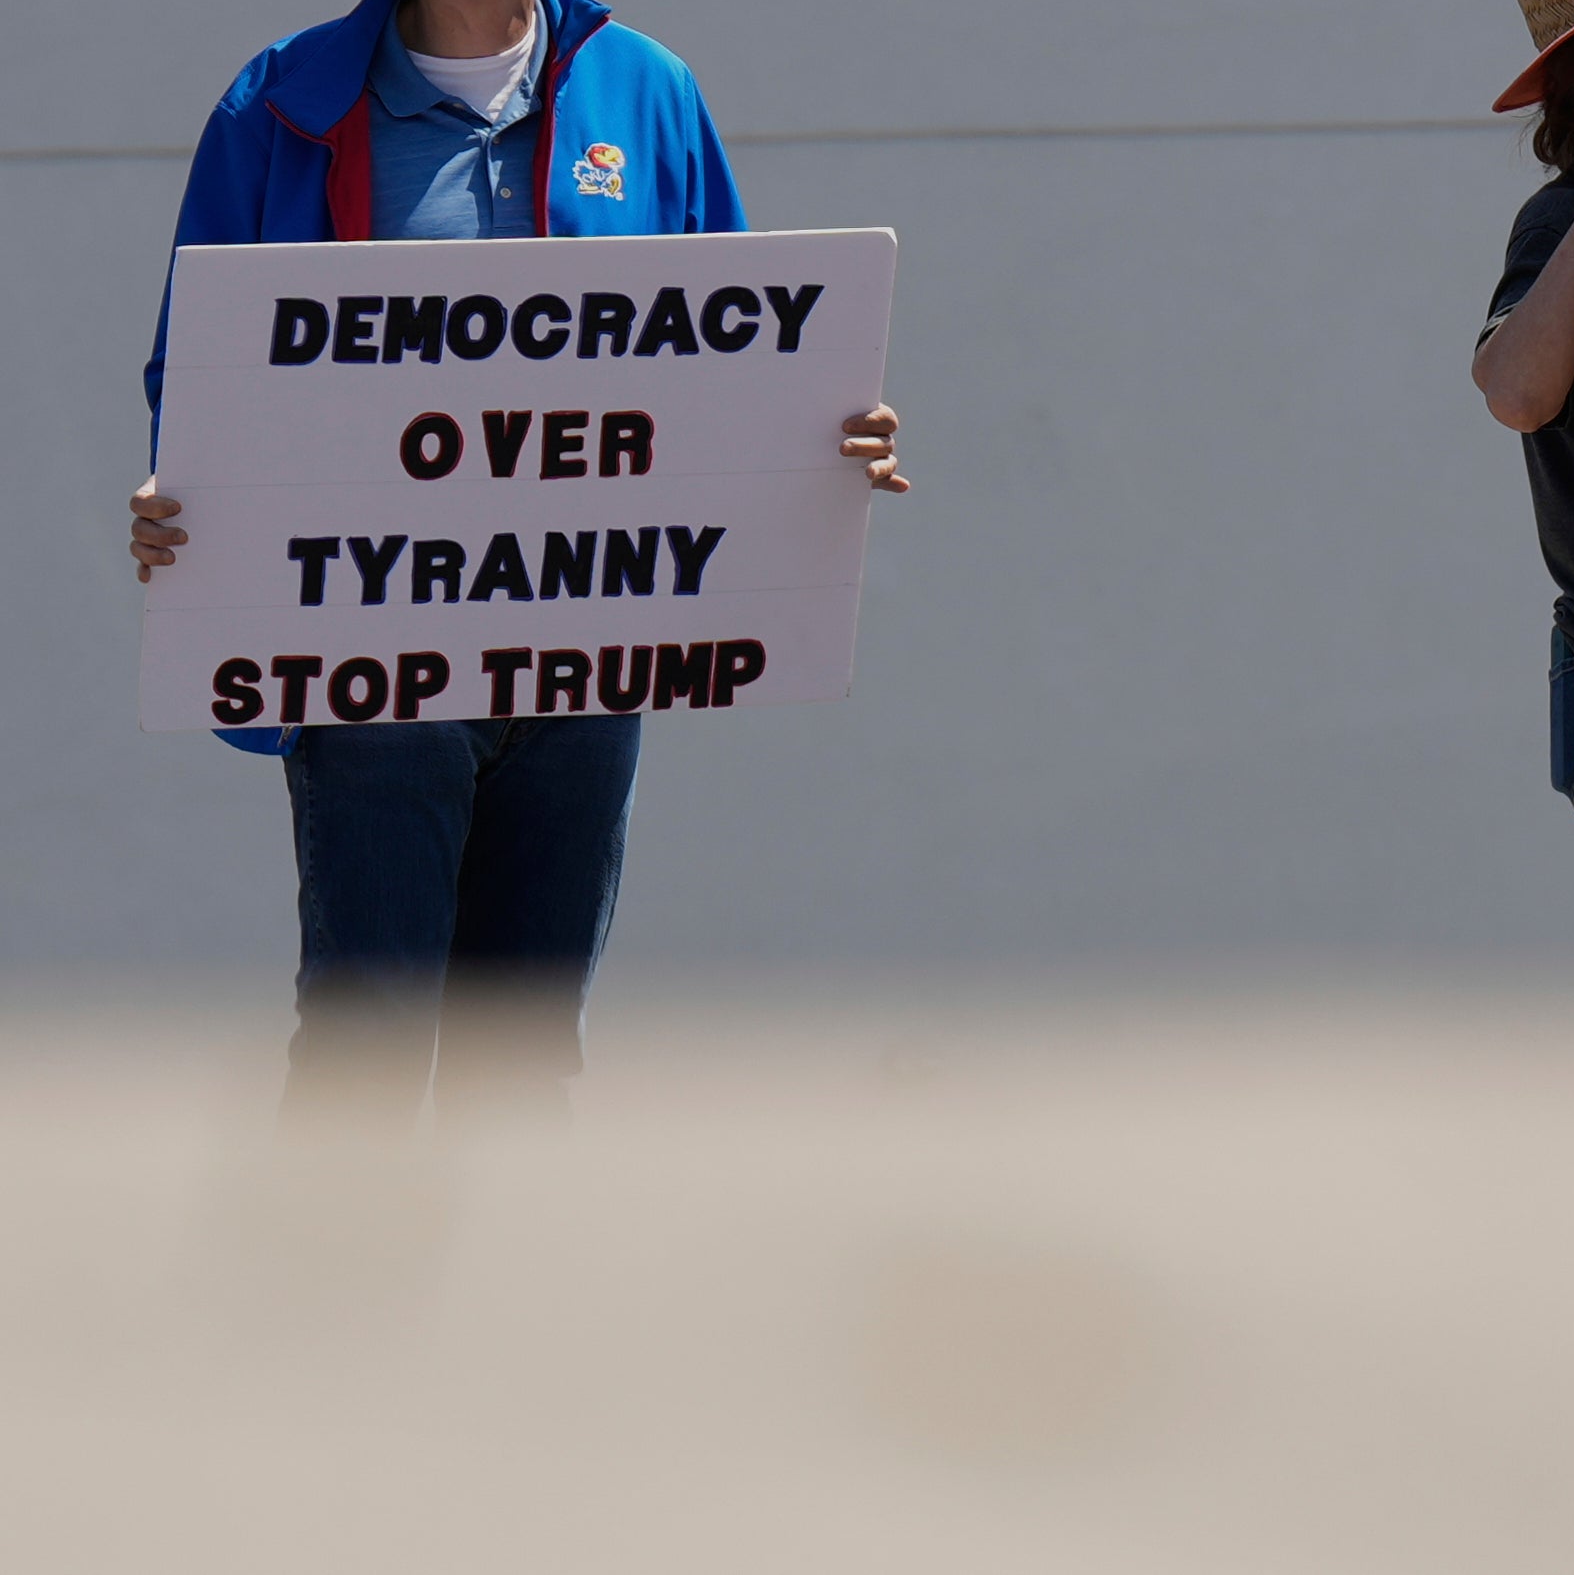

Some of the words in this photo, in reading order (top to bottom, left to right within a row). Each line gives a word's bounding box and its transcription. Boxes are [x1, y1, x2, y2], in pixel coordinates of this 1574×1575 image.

[269, 283, 825, 366] DEMOCRACY
[400, 410, 654, 480] OVER
[288, 526, 727, 606] TYRANNY
[211, 652, 450, 726] STOP
[481, 639, 766, 717] TRUMP
